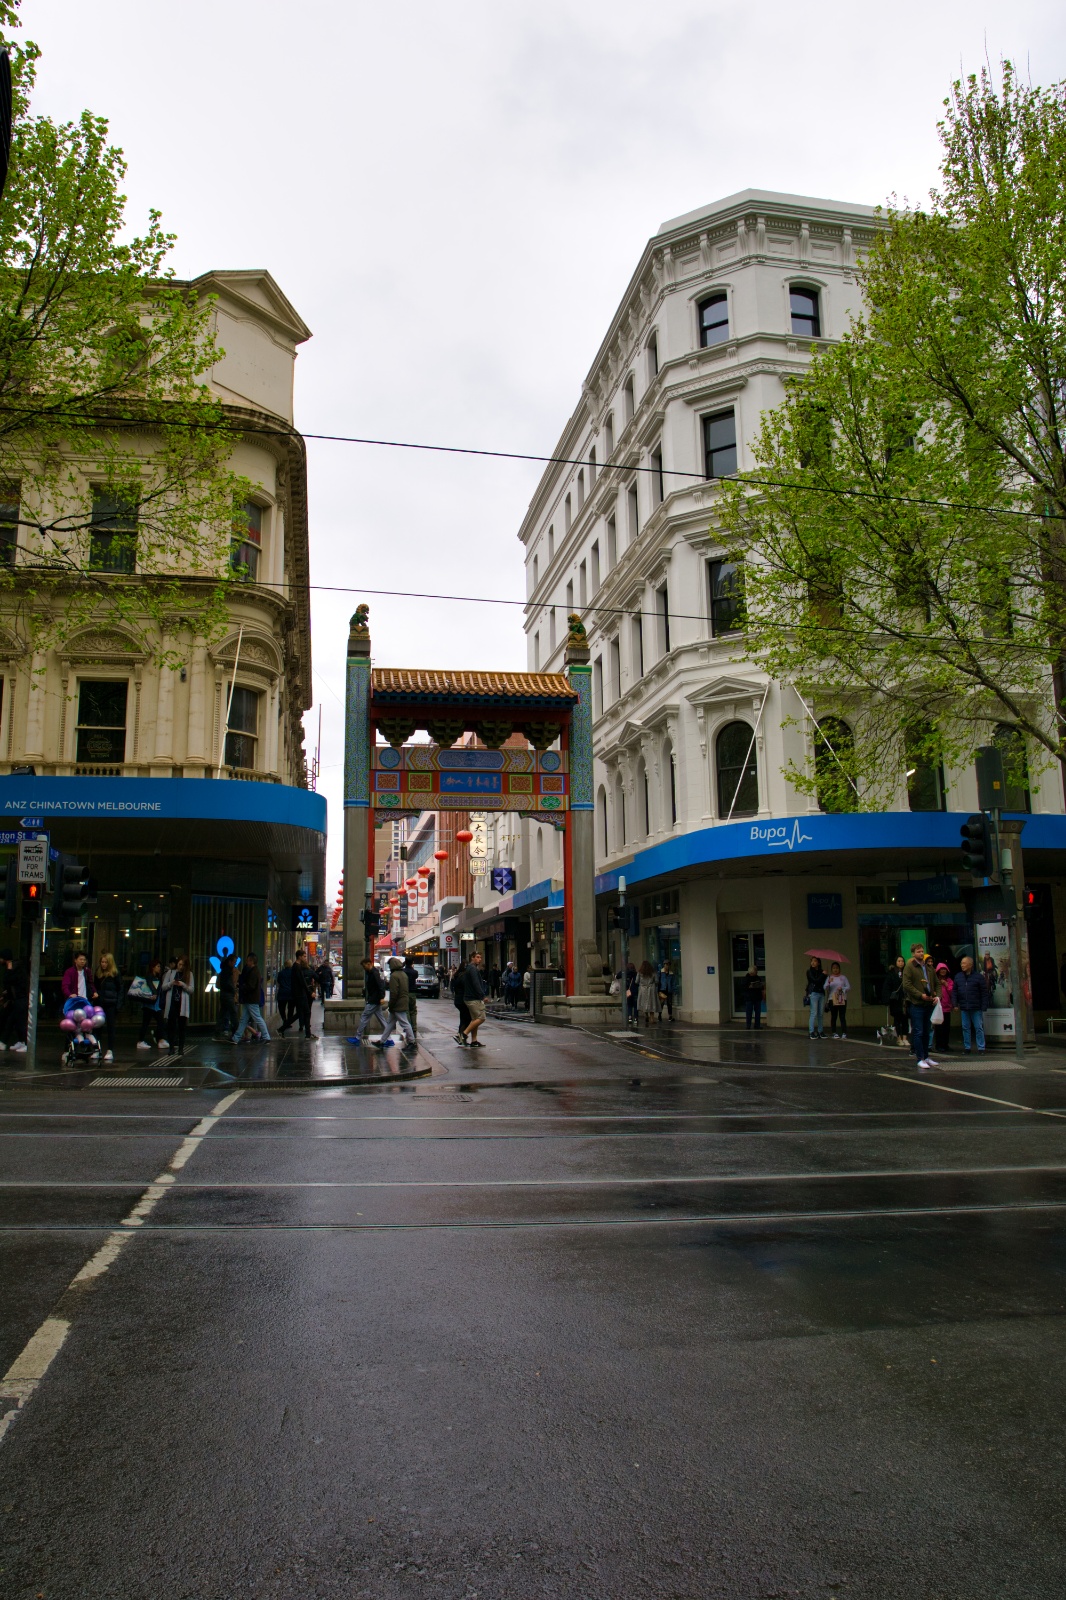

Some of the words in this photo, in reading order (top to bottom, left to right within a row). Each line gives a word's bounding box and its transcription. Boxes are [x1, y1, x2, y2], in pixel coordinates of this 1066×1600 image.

[4, 800, 28, 809] ANZ
[29, 801, 95, 810] CHINATOWN
[97, 801, 161, 811] MELBOURNE
[17, 831, 26, 840] St
[750, 826, 787, 842] Bupa
[811, 896, 829, 905] Bupa
[296, 921, 314, 929] ANZ
